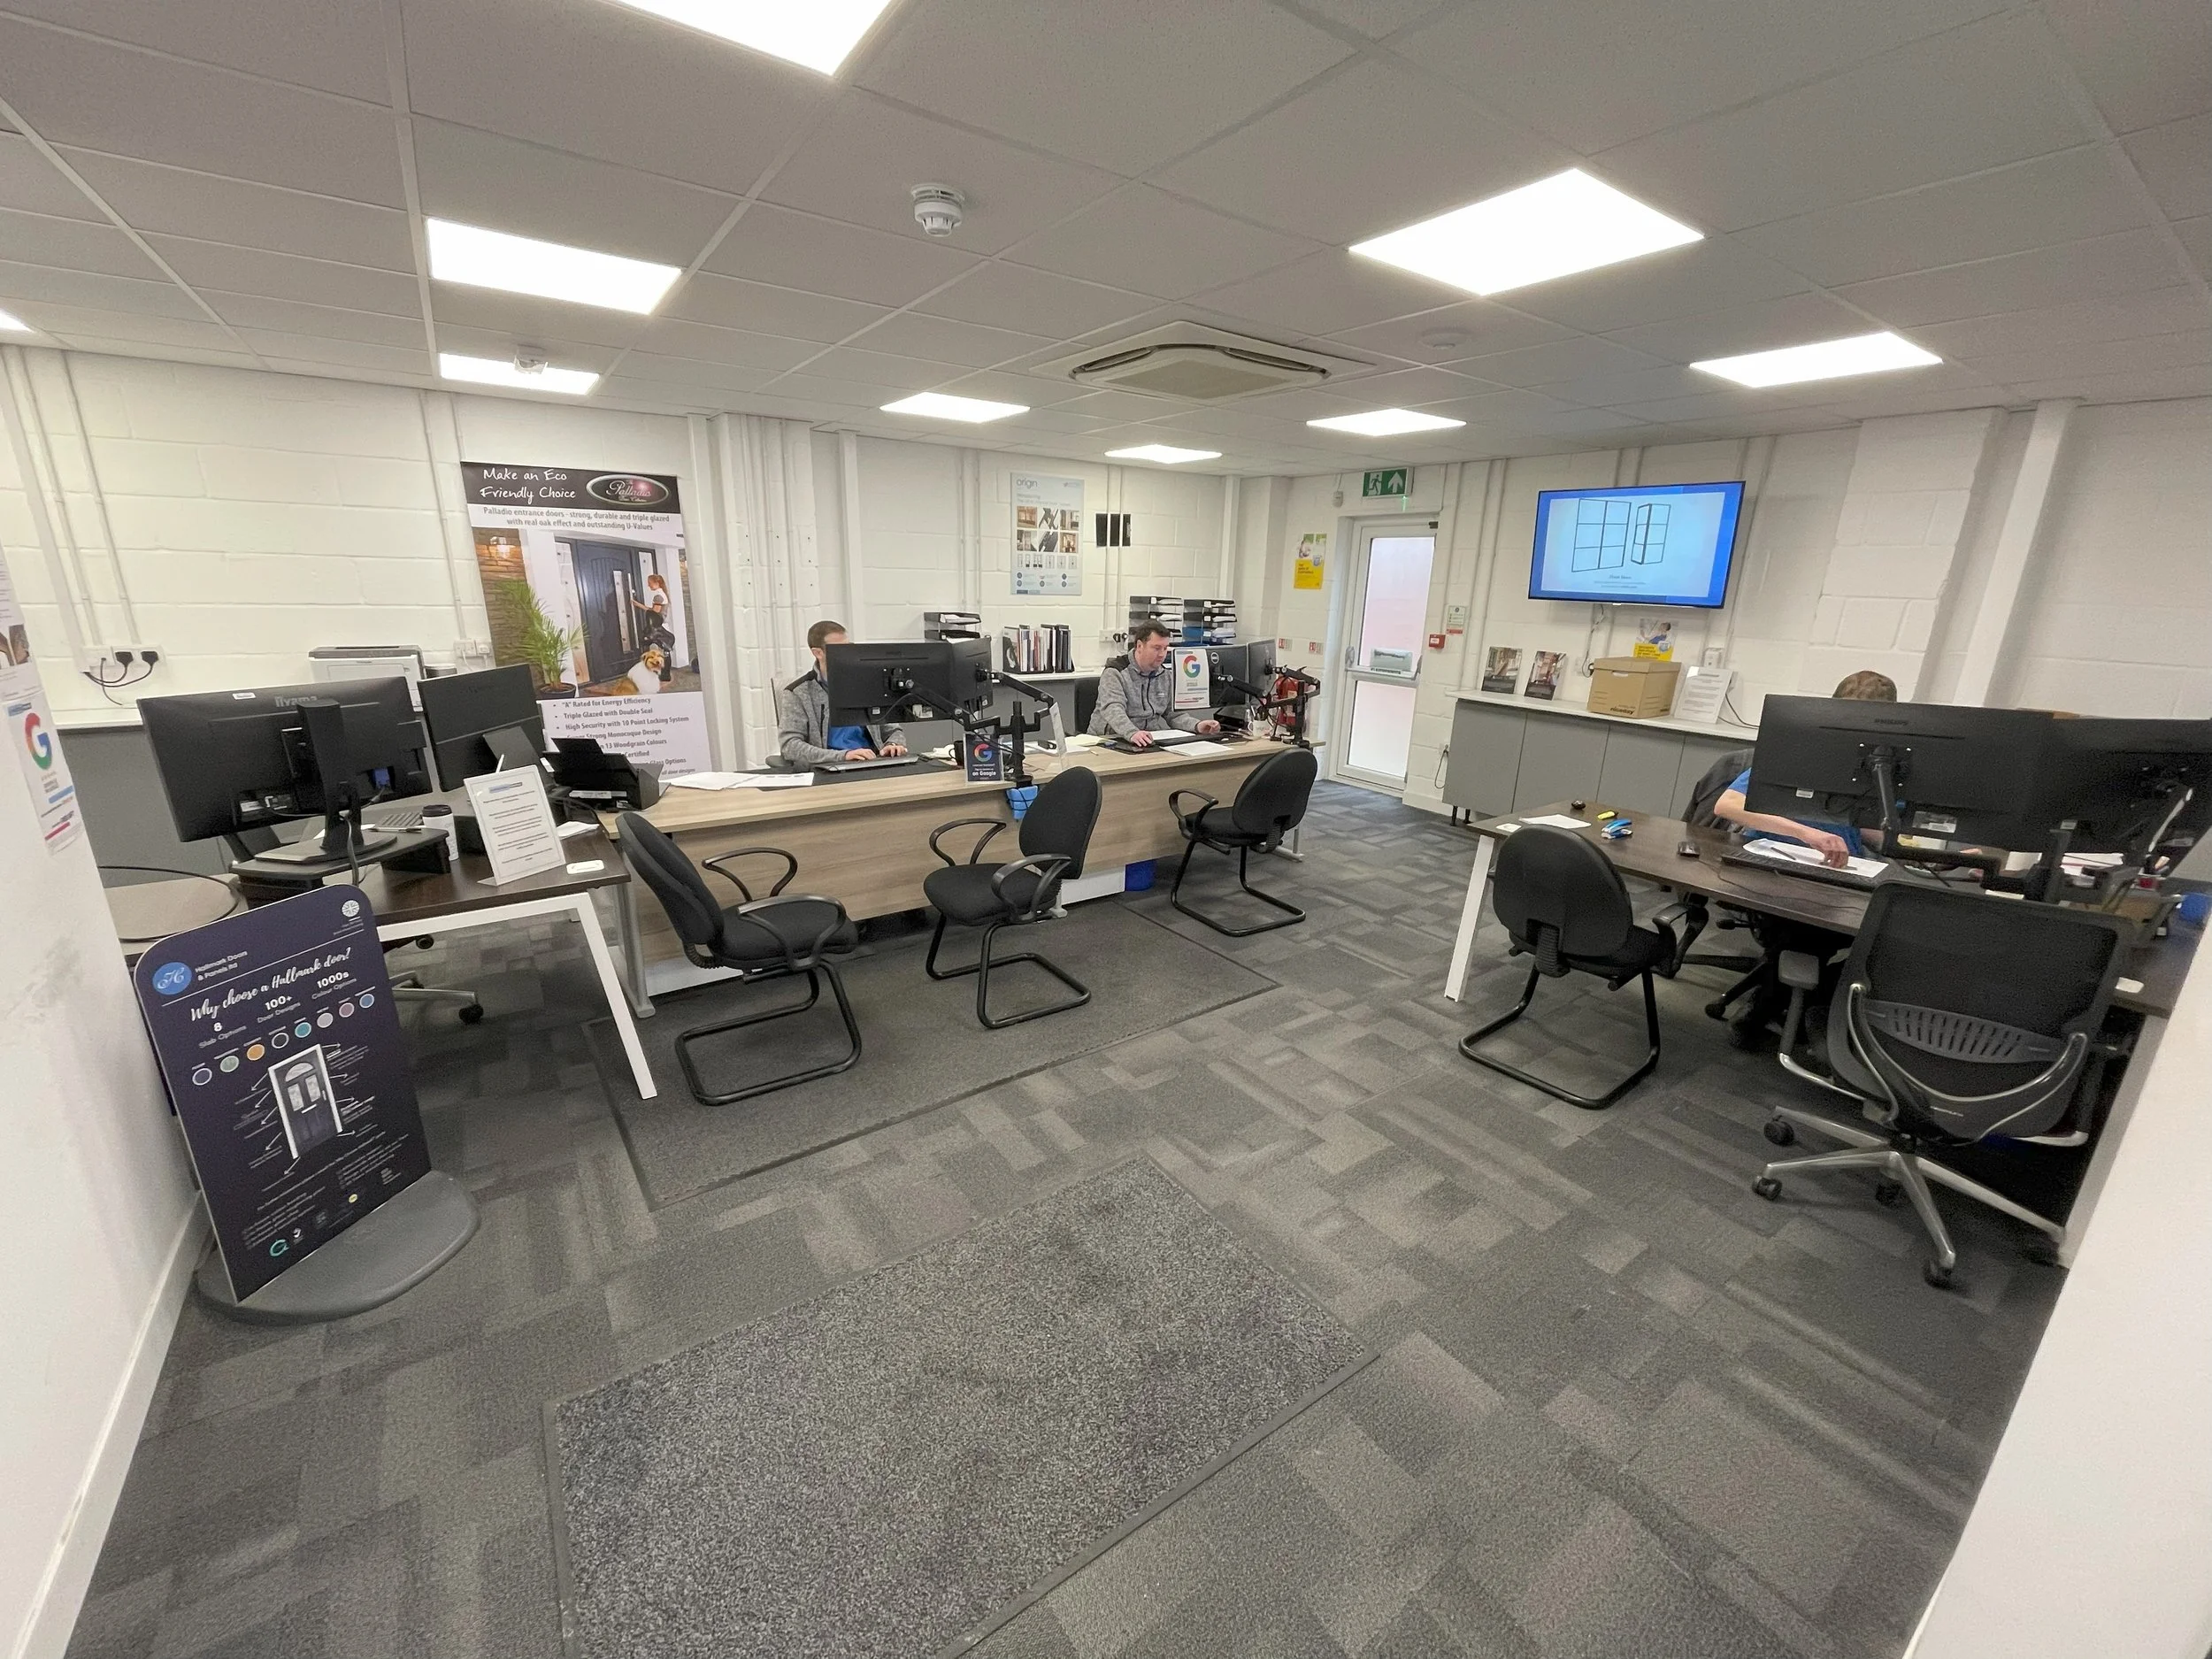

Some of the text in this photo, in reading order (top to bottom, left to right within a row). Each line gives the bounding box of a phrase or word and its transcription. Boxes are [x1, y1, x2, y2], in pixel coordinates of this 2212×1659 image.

[484, 467, 567, 481] Make an Eco
[1016, 478, 1038, 489] origin
[479, 486, 576, 505] Friendly Choice
[483, 507, 512, 515] Palladio
[587, 522, 625, 530] outstanding
[195, 951, 248, 973] Hallmark Doors
[191, 998, 220, 1022] Why
[223, 988, 258, 1008] choose
[271, 958, 322, 988] Hallmark
[324, 946, 351, 967] door?
[317, 972, 349, 988] 1000s
[265, 996, 292, 1010] 100+
[257, 1002, 301, 1023] Door Designs
[214, 1023, 222, 1032] 8
